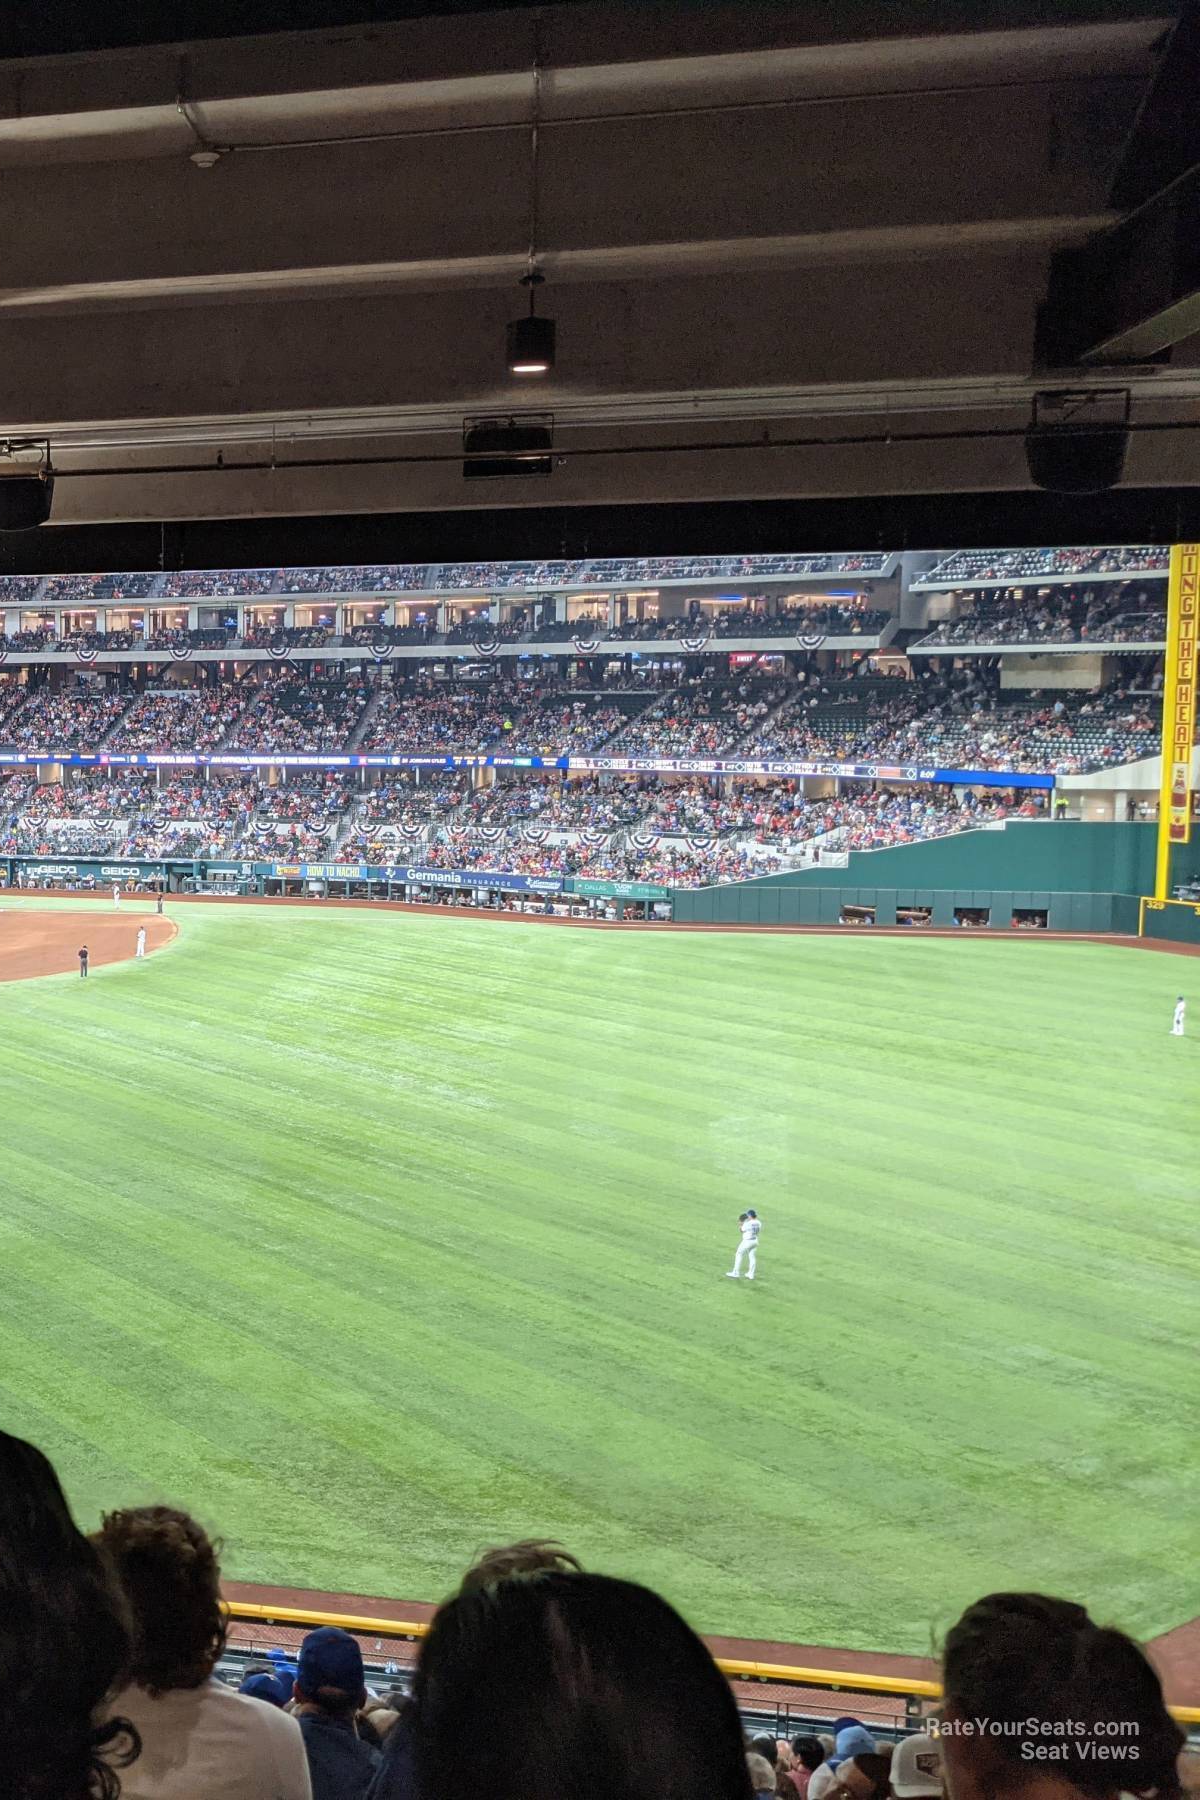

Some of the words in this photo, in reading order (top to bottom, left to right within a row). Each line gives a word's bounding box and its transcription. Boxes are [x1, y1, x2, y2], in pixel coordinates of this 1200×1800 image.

[1179, 621, 1193, 679] THE
[1176, 685, 1191, 762] HEAT
[147, 756, 175, 764] TOYOTA
[39, 865, 77, 874] GEICO
[101, 867, 140, 876] GEICO
[307, 865, 323, 876] HOW
[326, 866, 335, 876] TO
[407, 869, 461, 884] Germania
[463, 879, 511, 888] INSURANCE
[1146, 900, 1165, 910] 329
